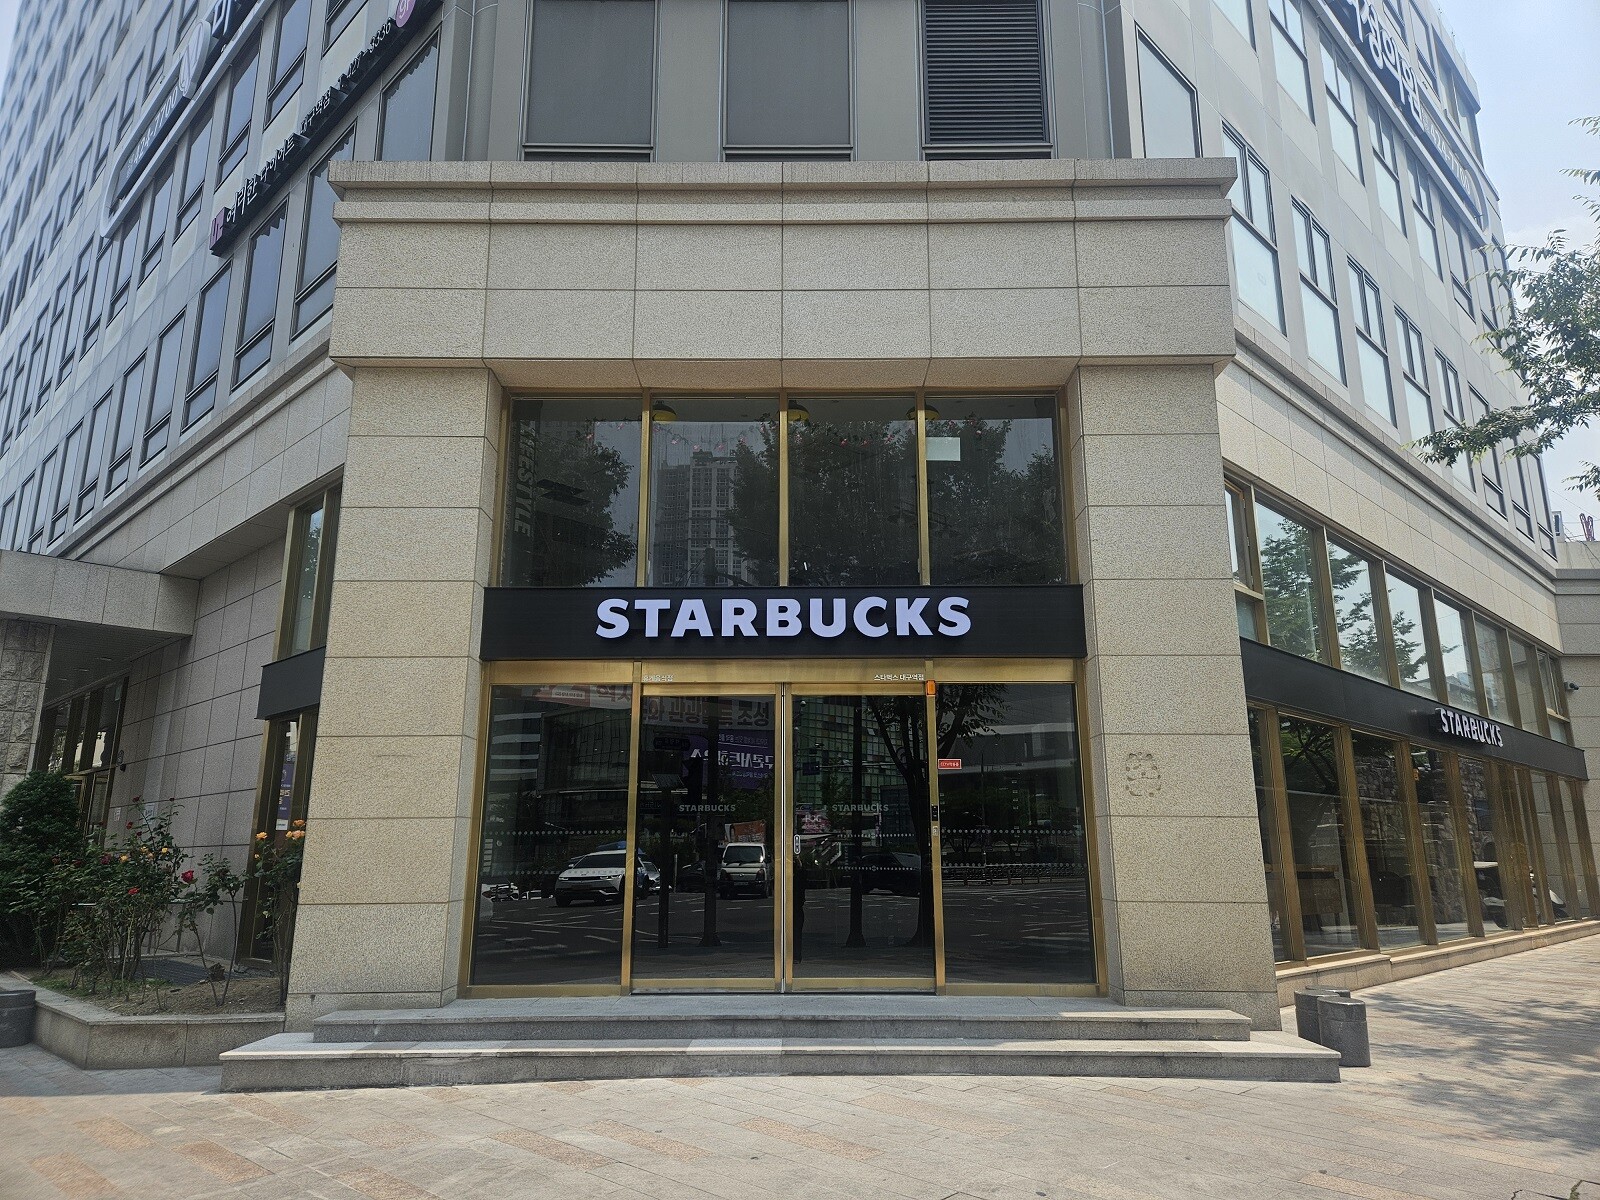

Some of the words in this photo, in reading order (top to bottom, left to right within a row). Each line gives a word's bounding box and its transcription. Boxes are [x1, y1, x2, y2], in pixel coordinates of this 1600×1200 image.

[260, 138, 295, 181] 다이어트
[595, 596, 972, 639] STARBUCKS
[874, 674, 898, 682] 스타벅스
[899, 673, 924, 682] 대구역점
[737, 700, 770, 726] 조성
[1440, 708, 1504, 748] STARBUCKS
[678, 804, 736, 812] STARBUCKS
[831, 804, 889, 812] STARBUCKS
